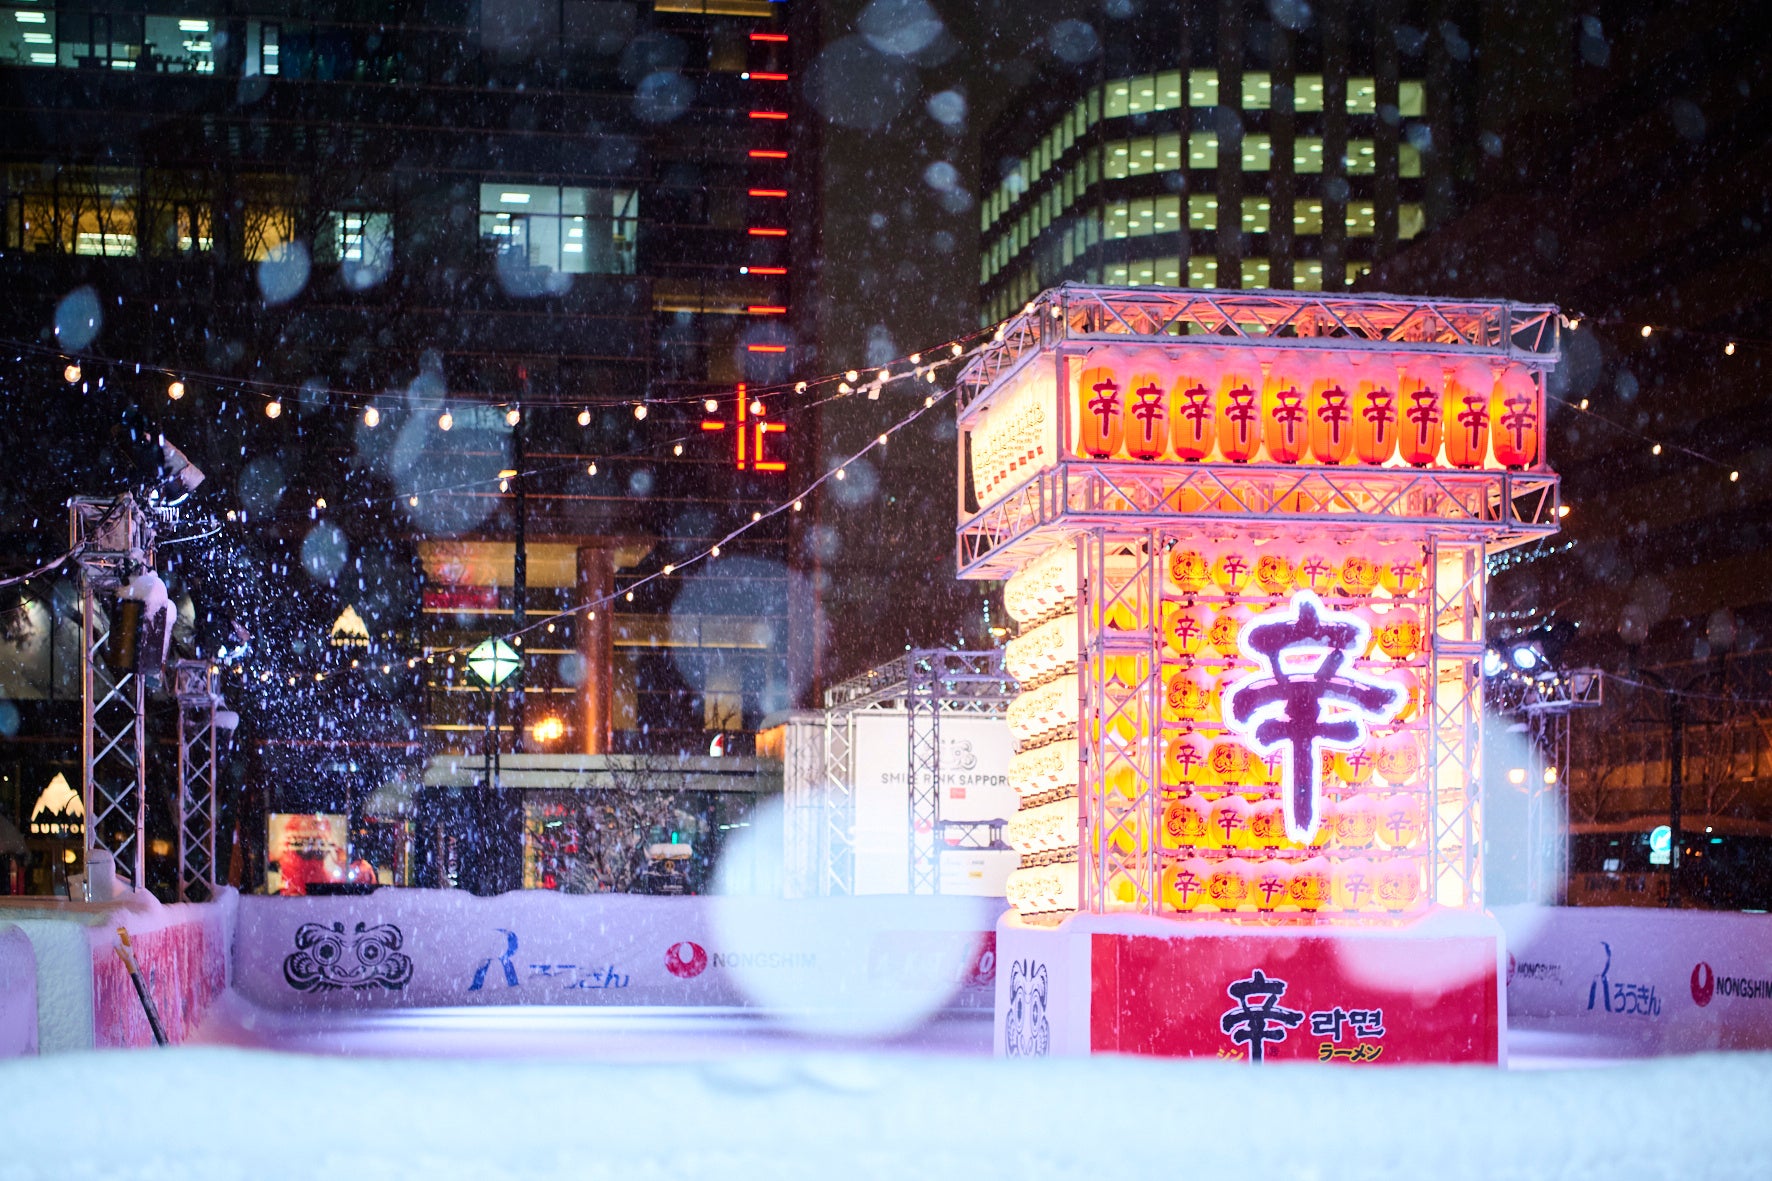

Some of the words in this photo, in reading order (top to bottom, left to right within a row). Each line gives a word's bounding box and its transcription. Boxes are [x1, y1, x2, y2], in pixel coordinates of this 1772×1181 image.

[1089, 378, 1120, 436] 辛
[1132, 383, 1165, 441] 辛
[1181, 384, 1211, 440] 辛
[1225, 384, 1256, 443] 辛
[1272, 386, 1307, 443] 辛
[1318, 385, 1349, 443] 辛
[1363, 386, 1395, 442] 辛
[1407, 386, 1438, 444] 辛
[1458, 394, 1489, 449] 辛
[1501, 393, 1536, 450] 辛
[1174, 615, 1201, 648] 辛
[1232, 600, 1398, 832] 辛
[881, 772, 918, 784] SMIE
[923, 773, 956, 785] RNK
[959, 775, 1010, 786] SAPPOR
[1176, 744, 1202, 776] 辛
[1217, 809, 1244, 840] 辛
[1174, 870, 1201, 903] 辛
[1222, 970, 1304, 1064] 辛
[1311, 1008, 1386, 1041] 라면
[1614, 983, 1662, 1016] ろうきん
[1319, 1043, 1383, 1063] ラーメン
